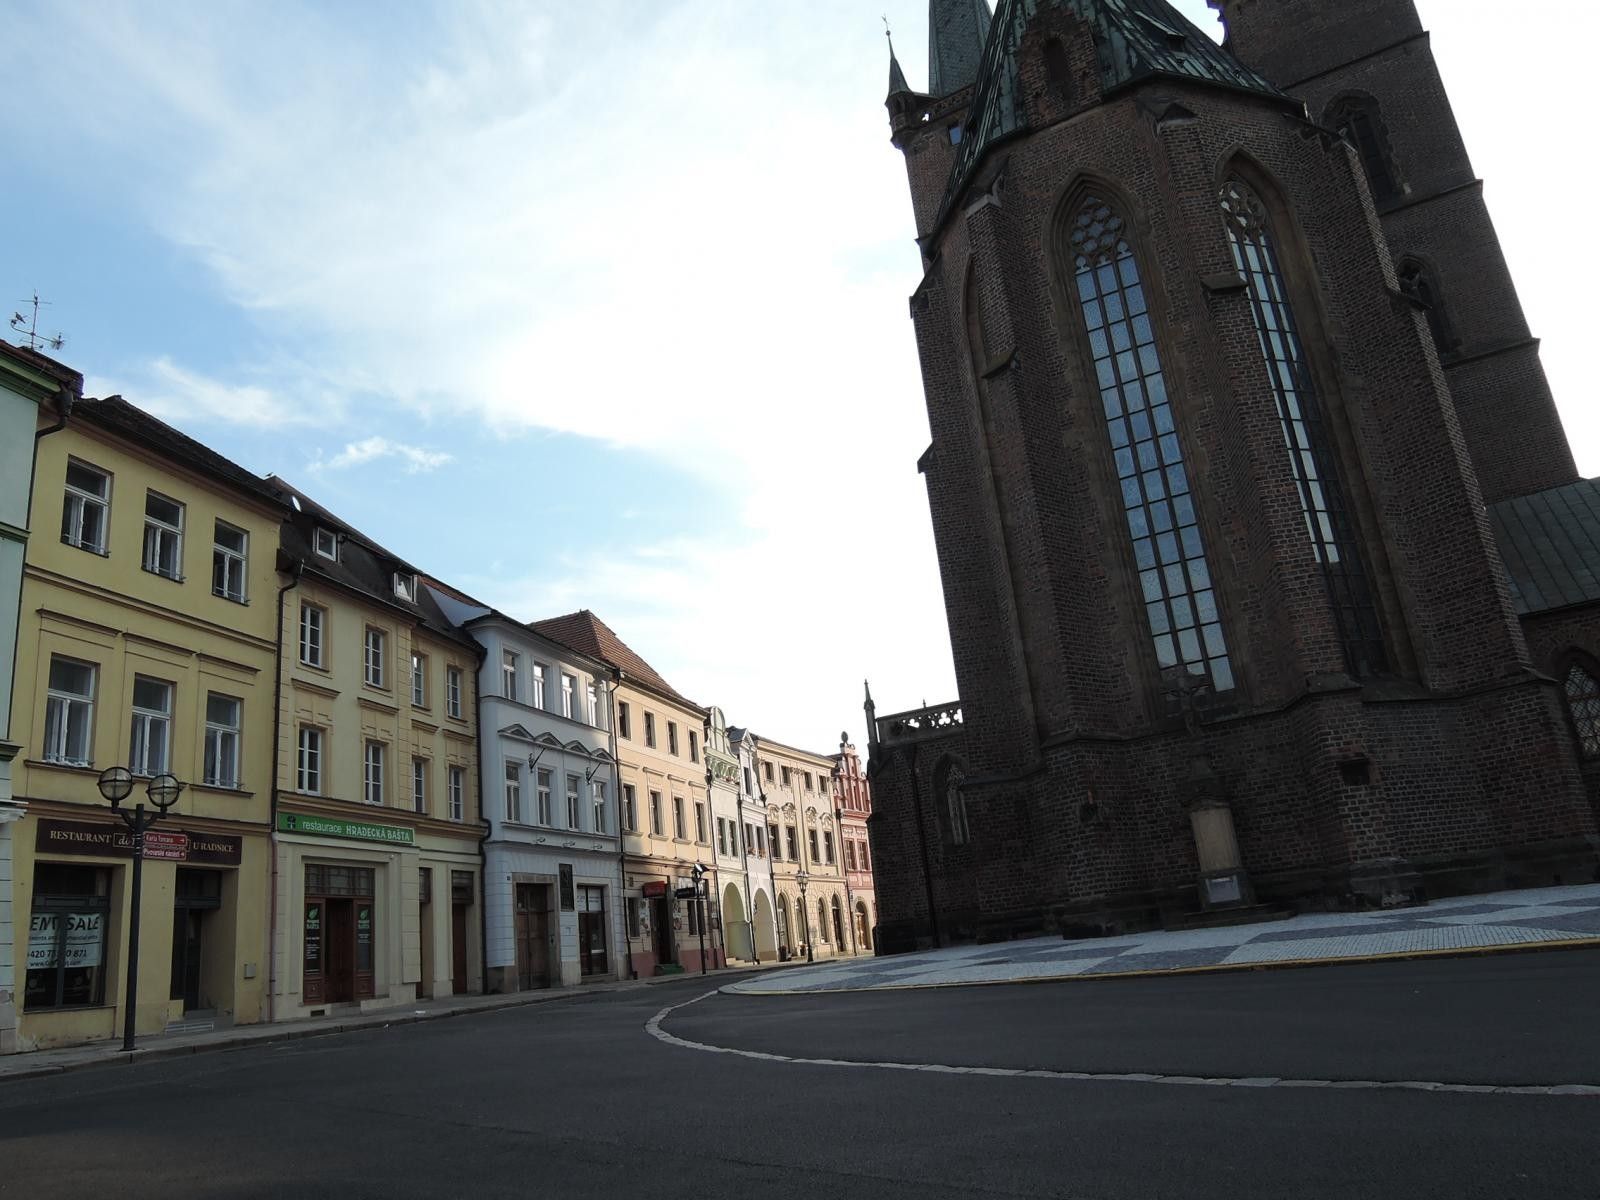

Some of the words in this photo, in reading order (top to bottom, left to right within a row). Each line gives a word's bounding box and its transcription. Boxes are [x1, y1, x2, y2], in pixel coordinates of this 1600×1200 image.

[50, 830, 112, 844] RESTAURANT
[302, 821, 342, 834] restaurace
[346, 824, 386, 839] HRADECKÁ
[387, 830, 410, 842] BAŠTA
[65, 916, 99, 931] SALE
